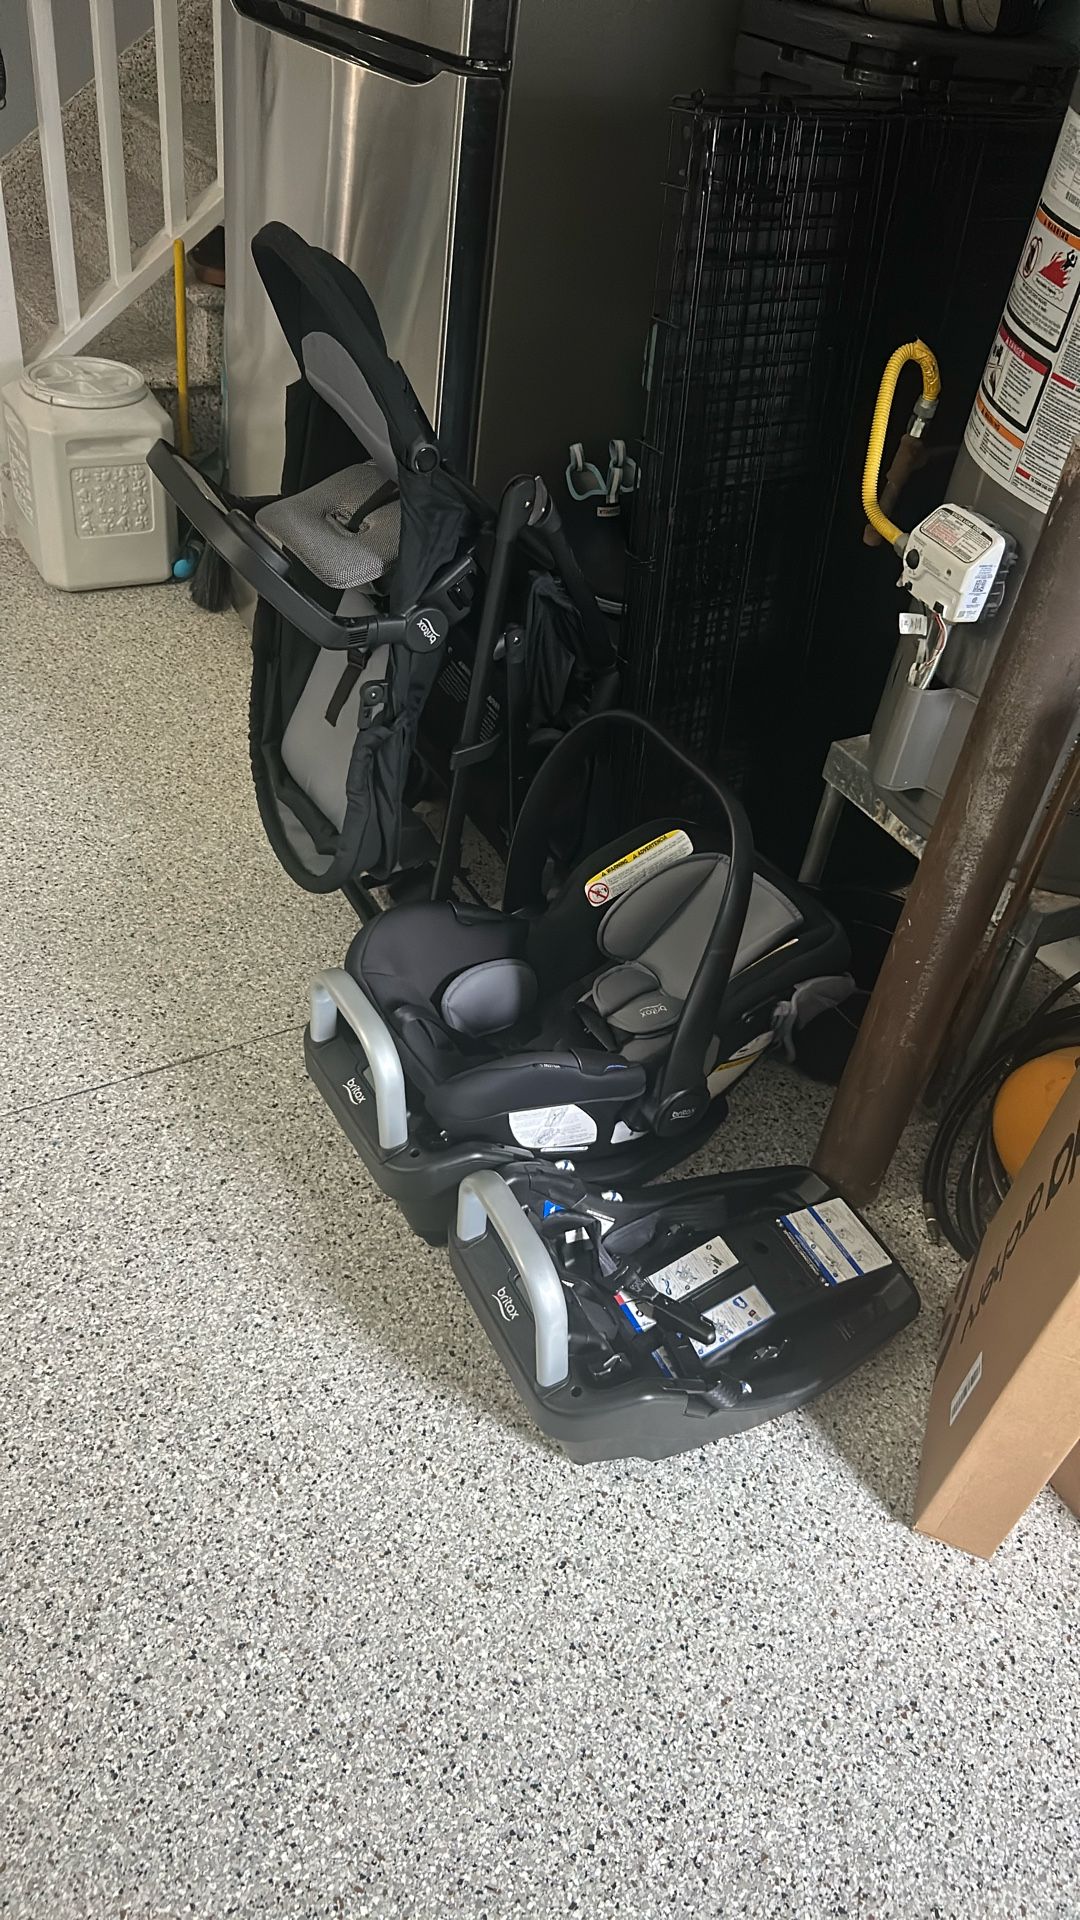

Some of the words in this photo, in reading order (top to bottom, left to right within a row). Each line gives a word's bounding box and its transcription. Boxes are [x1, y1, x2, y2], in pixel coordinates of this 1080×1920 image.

[416, 619, 437, 645] britax
[606, 858, 628, 874] WARNING
[640, 1005, 668, 1018] britax
[346, 1077, 367, 1104] britax
[497, 1286, 520, 1320] britax
